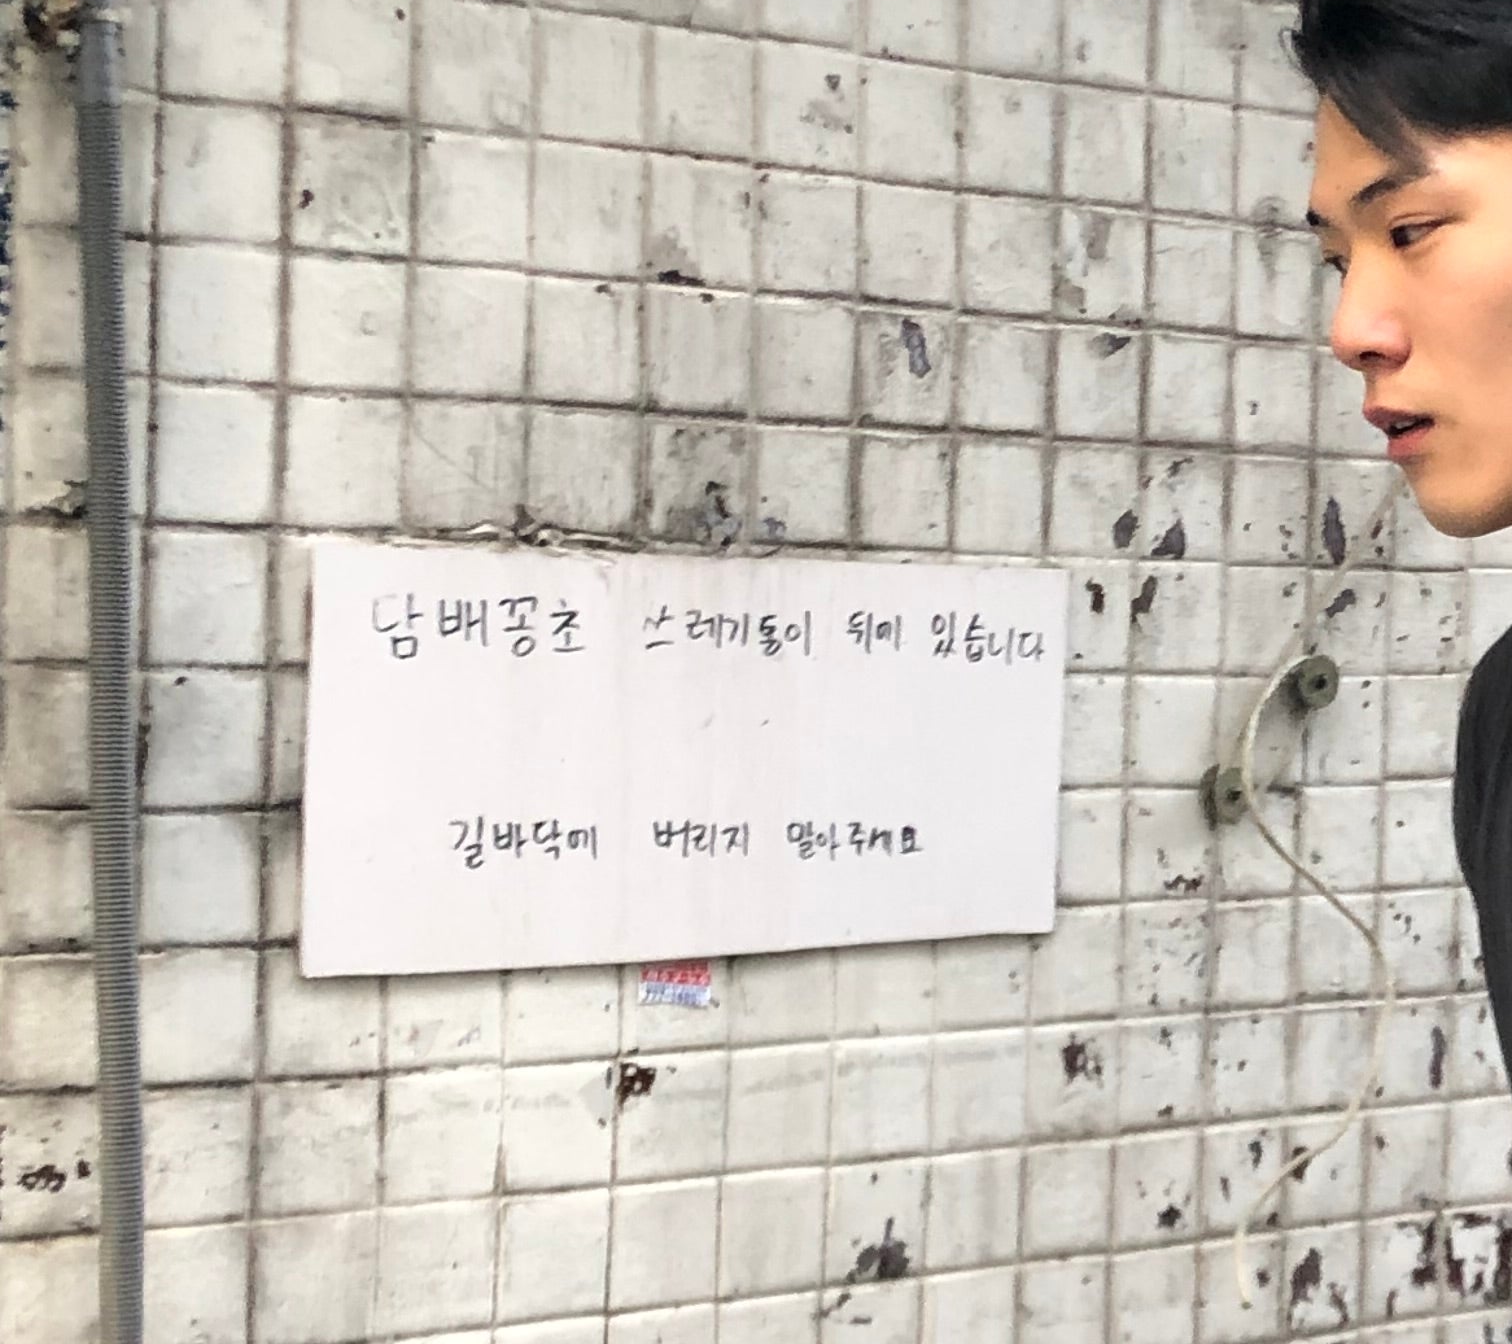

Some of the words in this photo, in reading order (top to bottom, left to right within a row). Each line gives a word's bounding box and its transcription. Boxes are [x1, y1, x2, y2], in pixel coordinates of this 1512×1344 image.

[372, 592, 587, 660] 담배꽁초
[846, 610, 902, 653] 뒤에
[930, 610, 1045, 666] 있습니다
[449, 815, 597, 870] 길바닥에
[652, 819, 749, 858] 버리지
[787, 820, 924, 861] 말아주세요
